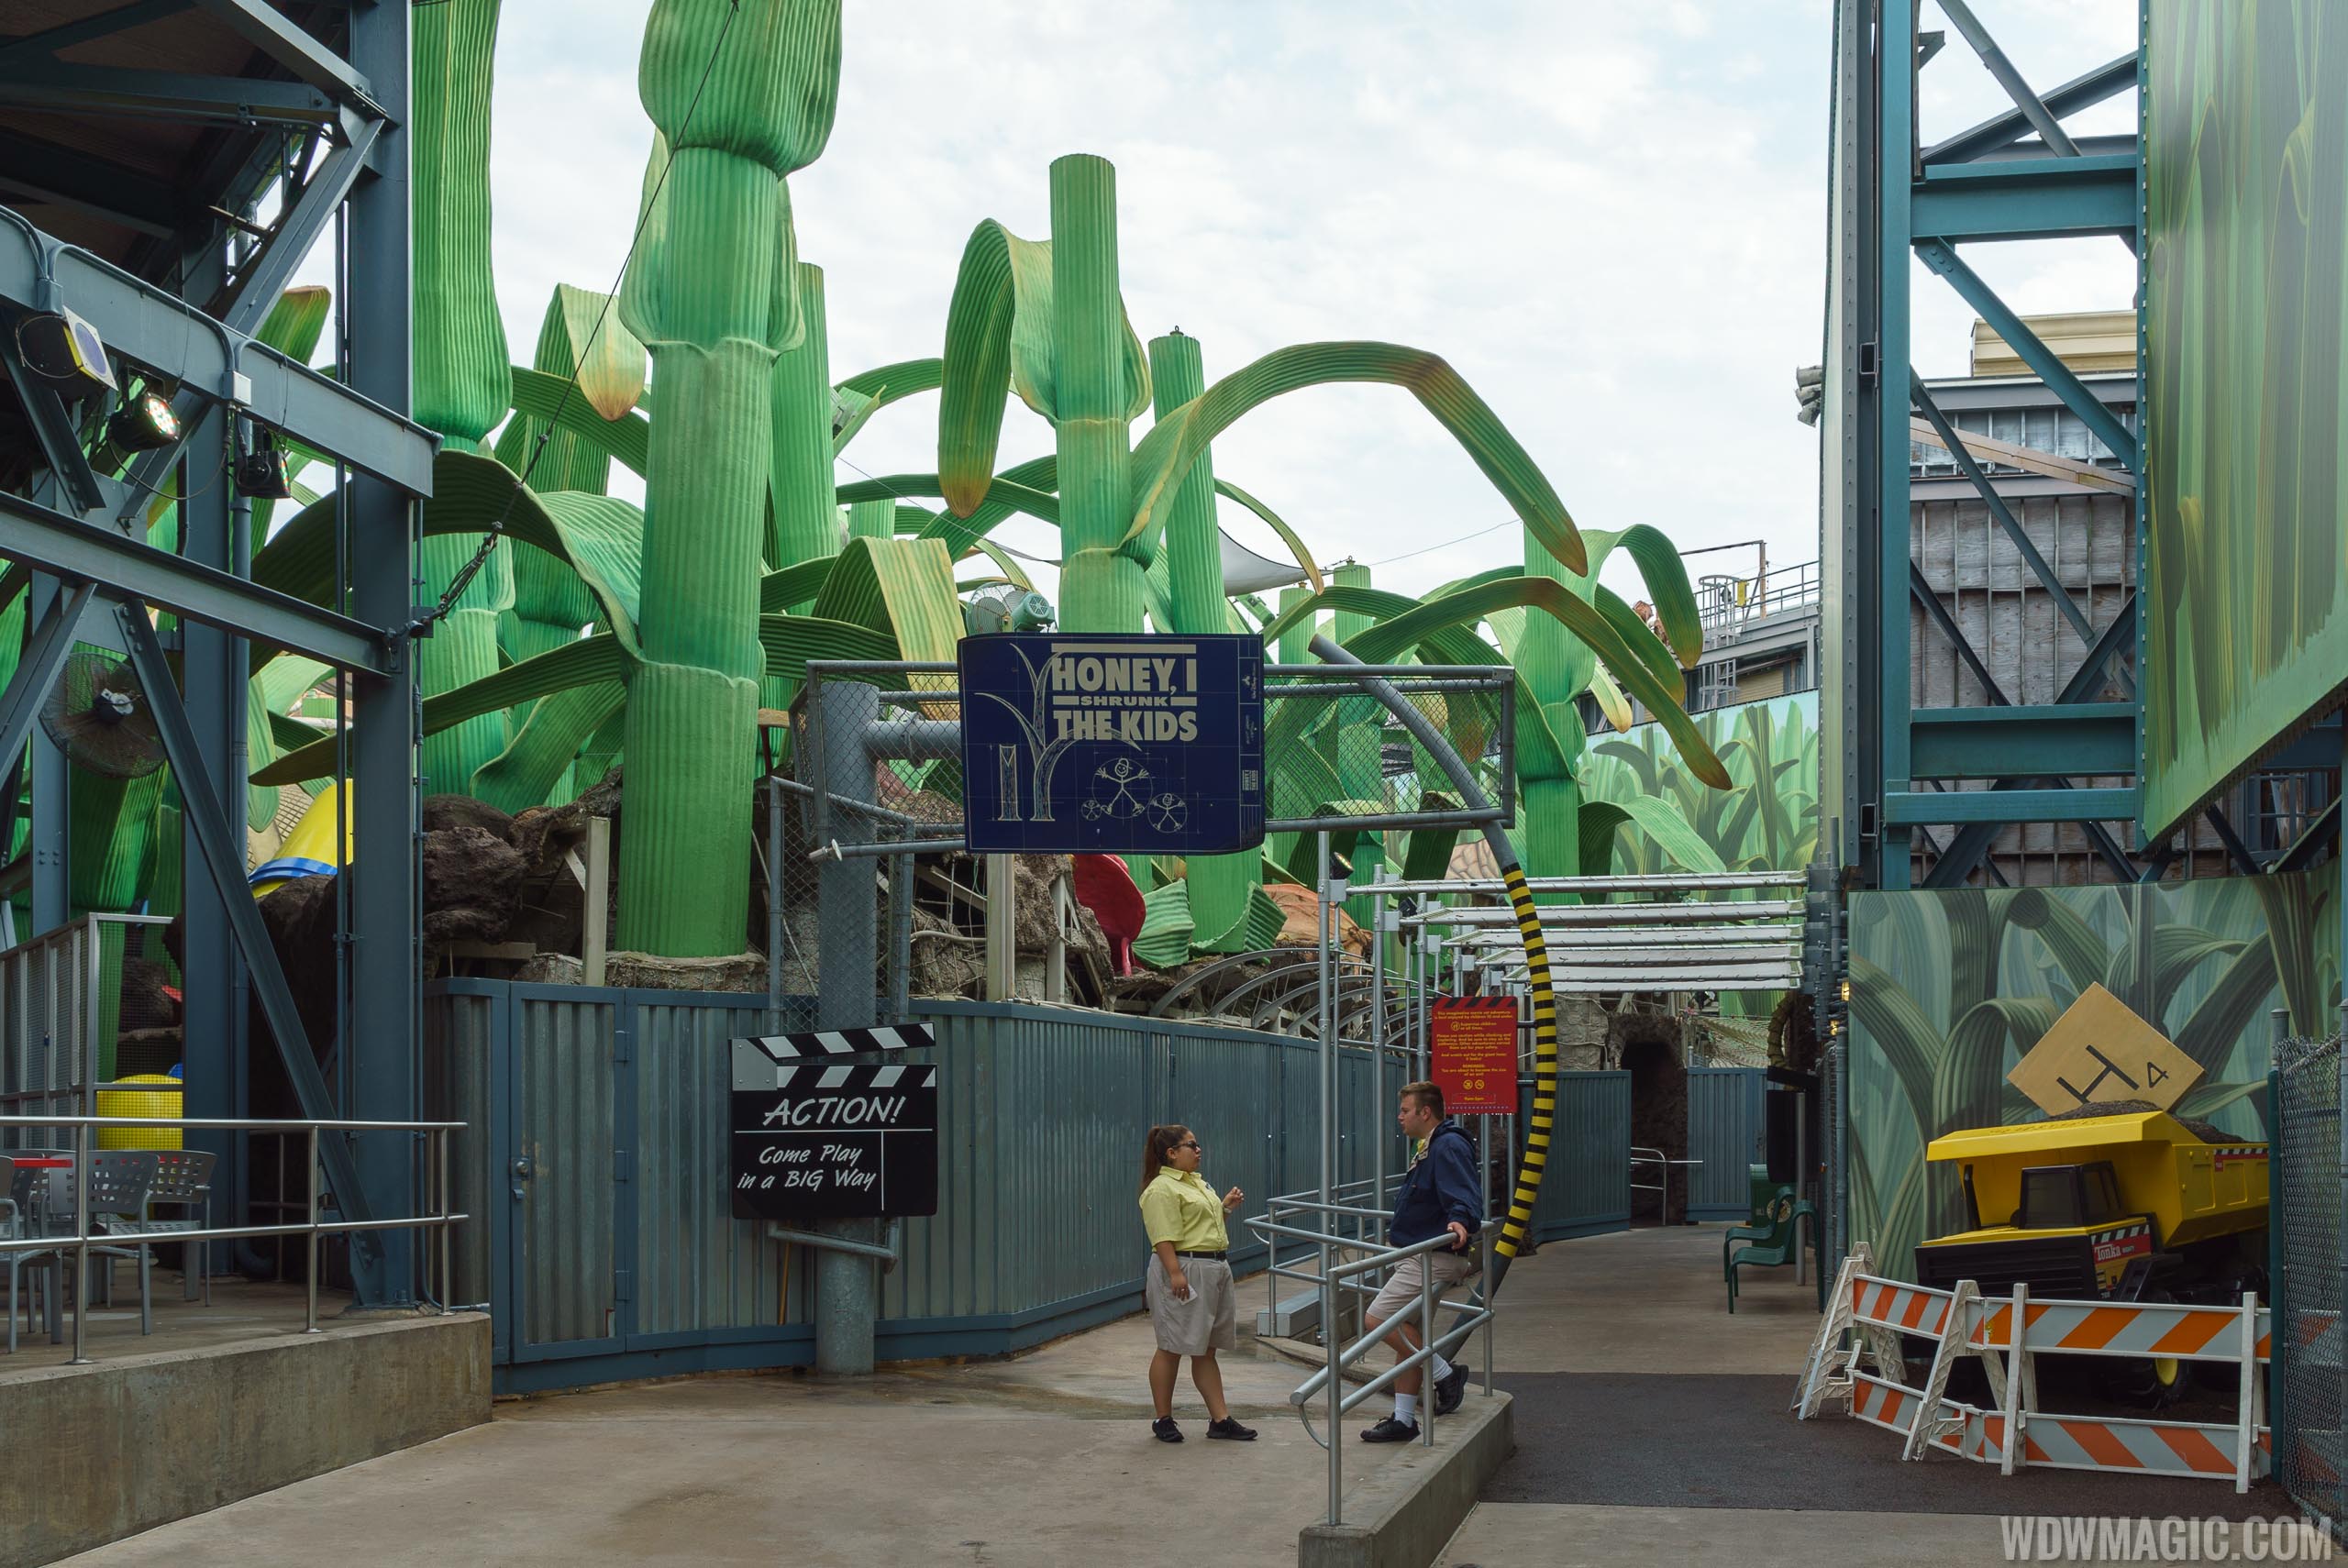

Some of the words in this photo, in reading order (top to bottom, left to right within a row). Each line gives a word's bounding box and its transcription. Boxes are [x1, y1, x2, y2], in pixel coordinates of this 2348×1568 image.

[1052, 657, 1178, 695] HONEY,
[1187, 658, 1197, 692] I
[1080, 695, 1168, 706] SHRUNK
[1053, 710, 1113, 741] THE
[1120, 710, 1198, 742] KIDS
[2146, 1061, 2169, 1088] 4
[762, 1096, 907, 1126] ACTION!
[759, 1145, 812, 1165] Come
[820, 1144, 863, 1167] Play
[737, 1173, 756, 1189] in
[760, 1174, 776, 1189] a
[784, 1169, 825, 1192] BIG
[835, 1168, 877, 1192] Way
[2094, 1243, 2121, 1262] Tonka
